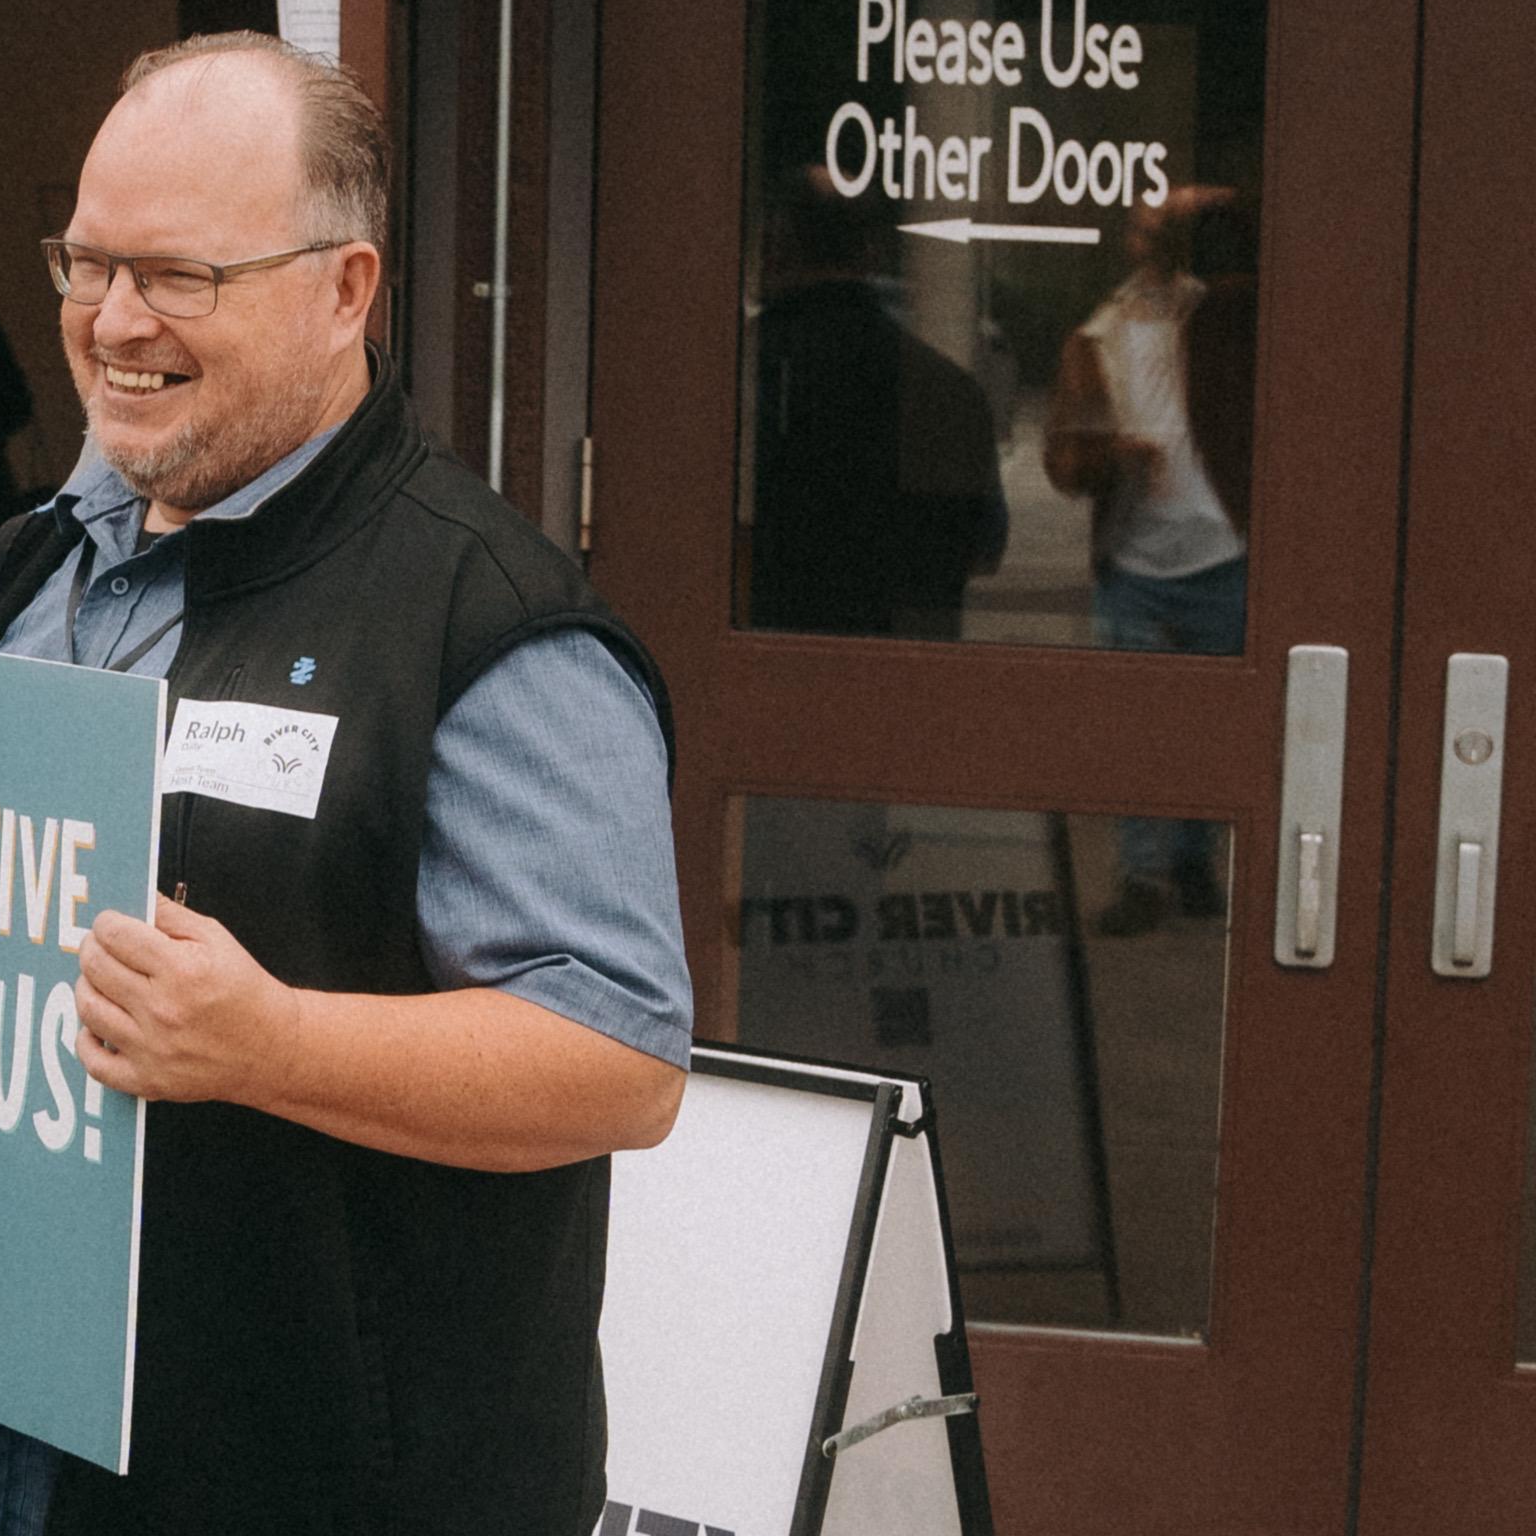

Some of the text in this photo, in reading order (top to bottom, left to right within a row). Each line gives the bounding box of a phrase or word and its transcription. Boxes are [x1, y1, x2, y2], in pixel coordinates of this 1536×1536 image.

[826, 101, 1168, 208] Other Doors
[185, 720, 245, 744] Ralph
[264, 724, 320, 753] RIVER CITY
